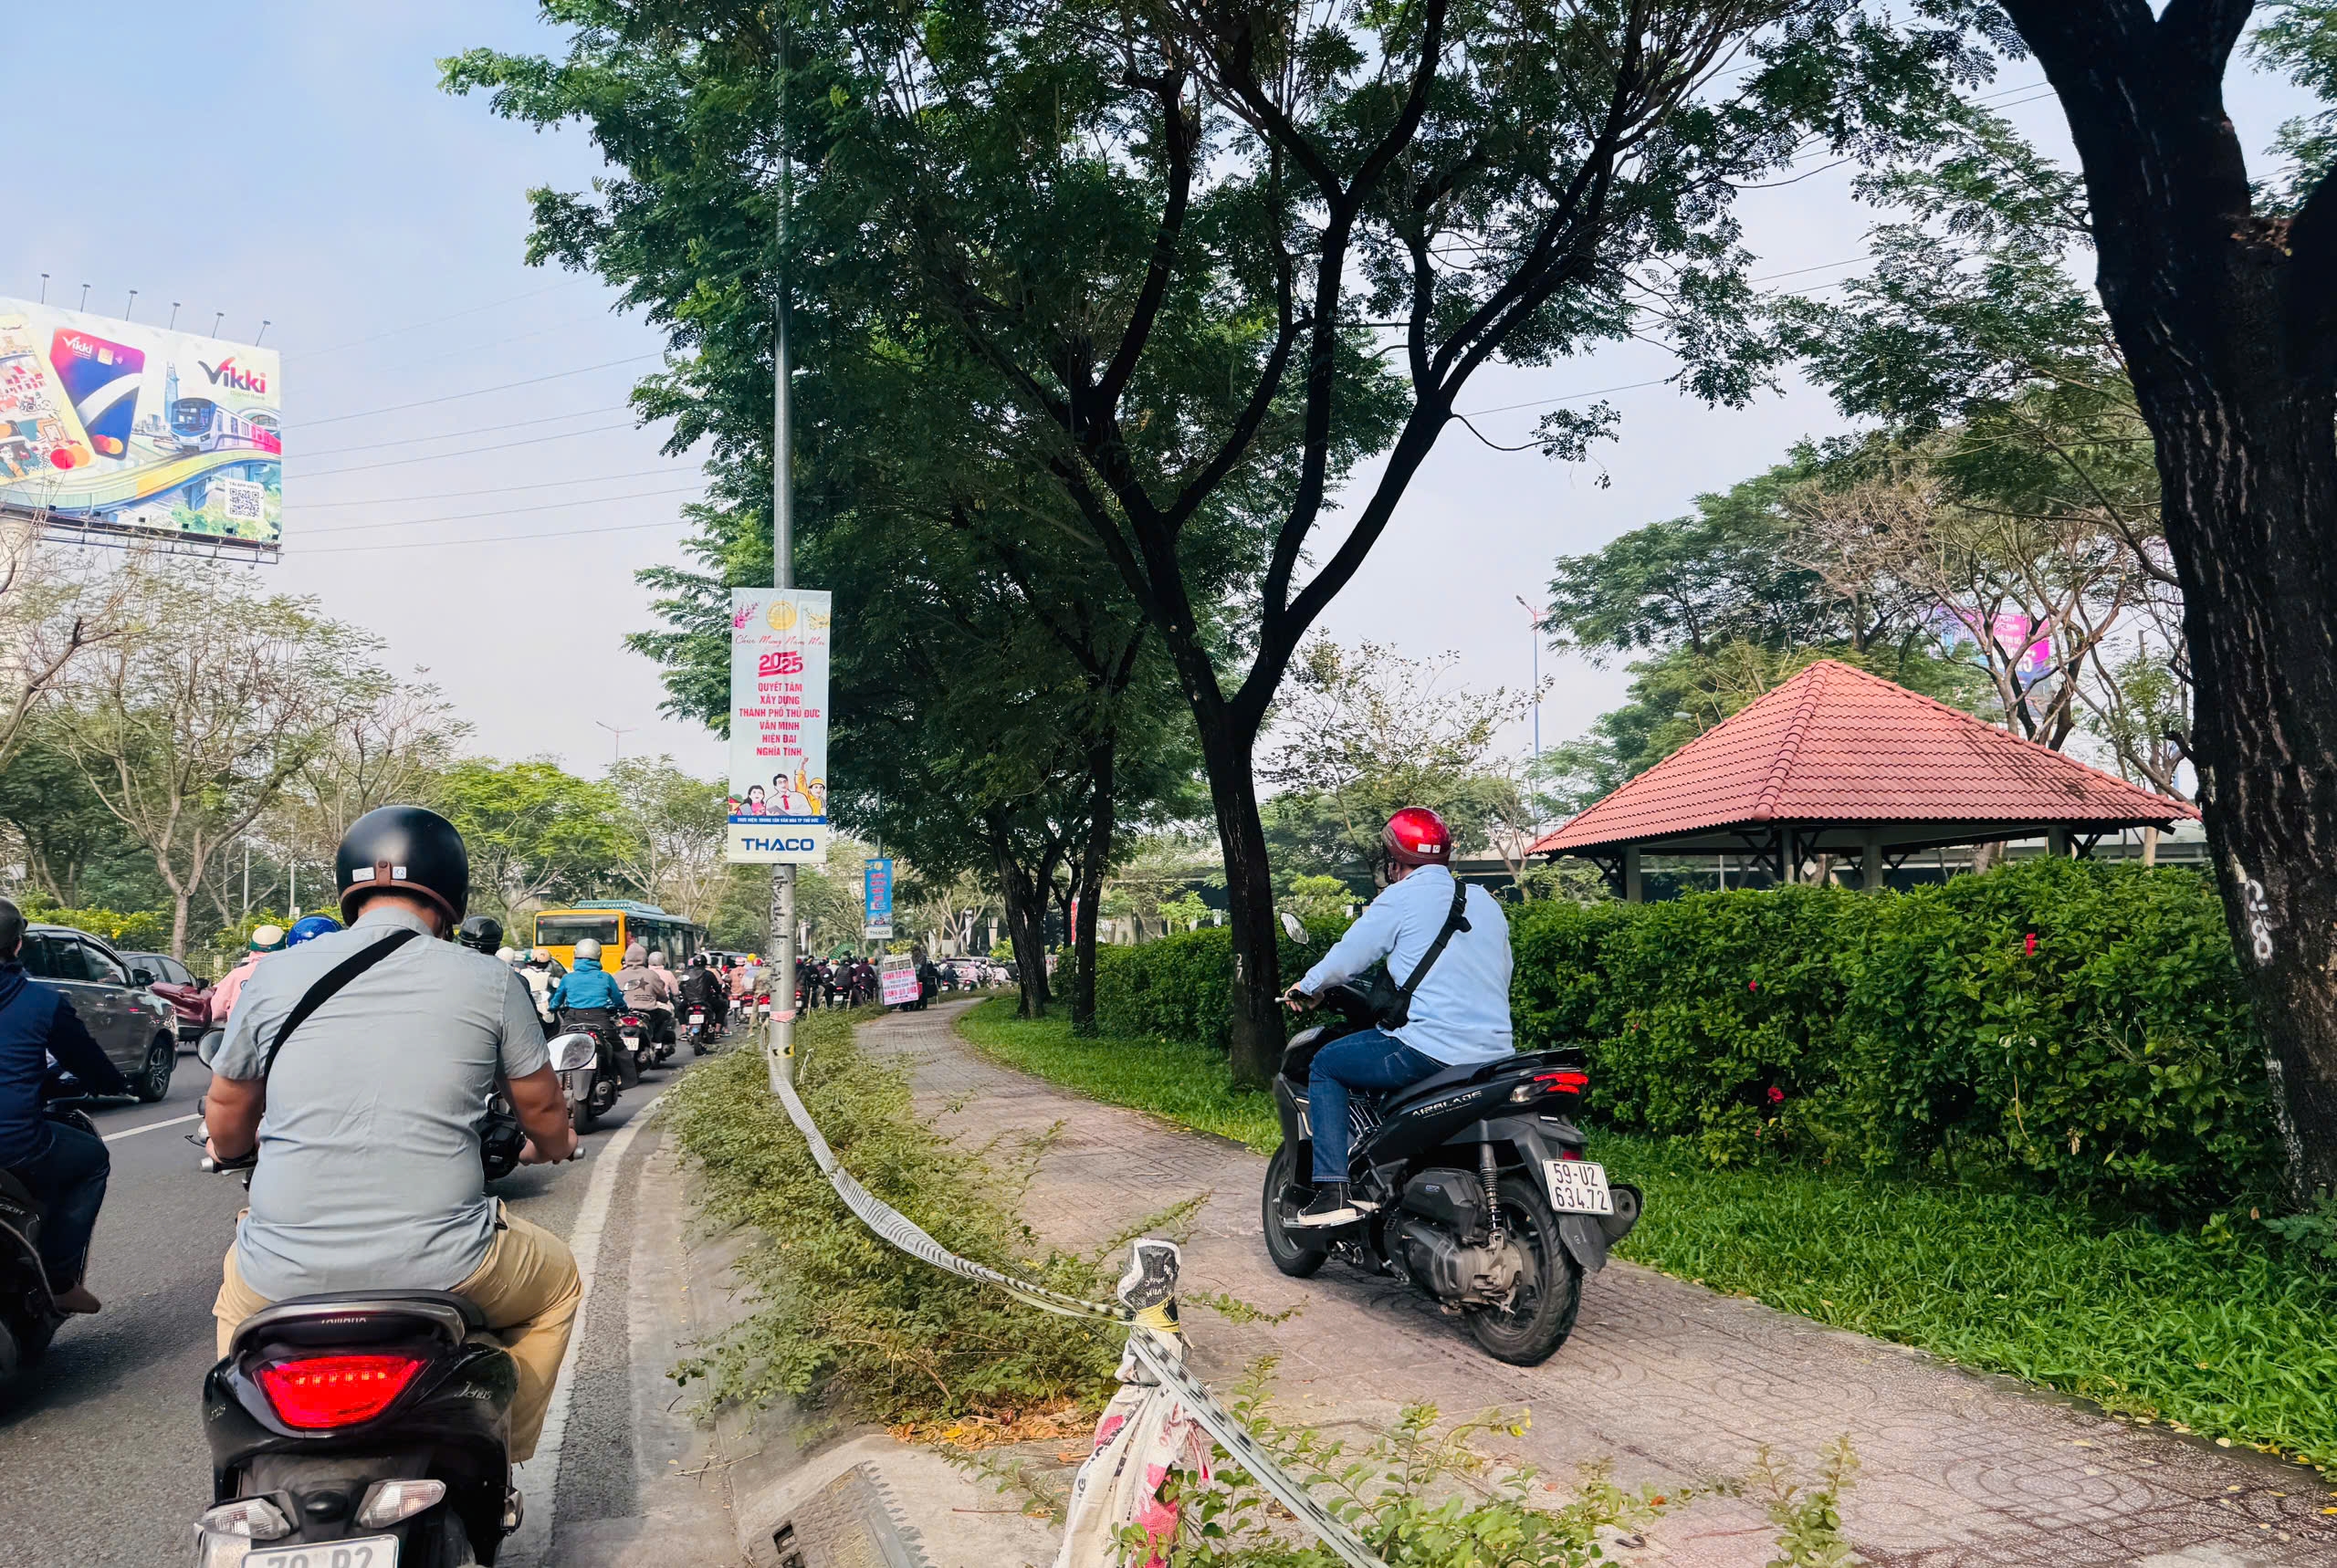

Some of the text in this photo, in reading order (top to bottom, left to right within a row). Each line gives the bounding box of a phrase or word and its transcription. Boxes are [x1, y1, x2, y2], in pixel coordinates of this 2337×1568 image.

[62, 336, 93, 355] Vikki
[198, 357, 267, 394] Vikki
[758, 651, 803, 677] 2025
[785, 682, 802, 692] TÂM
[760, 695, 800, 706] XÂY DỰNG
[778, 722, 800, 730] MINH
[761, 733, 797, 746] HIỆN ĐẠI
[741, 838, 814, 852] THACO
[1553, 1163, 1598, 1186] 59-U2
[1555, 1186, 1608, 1211] 634.72
